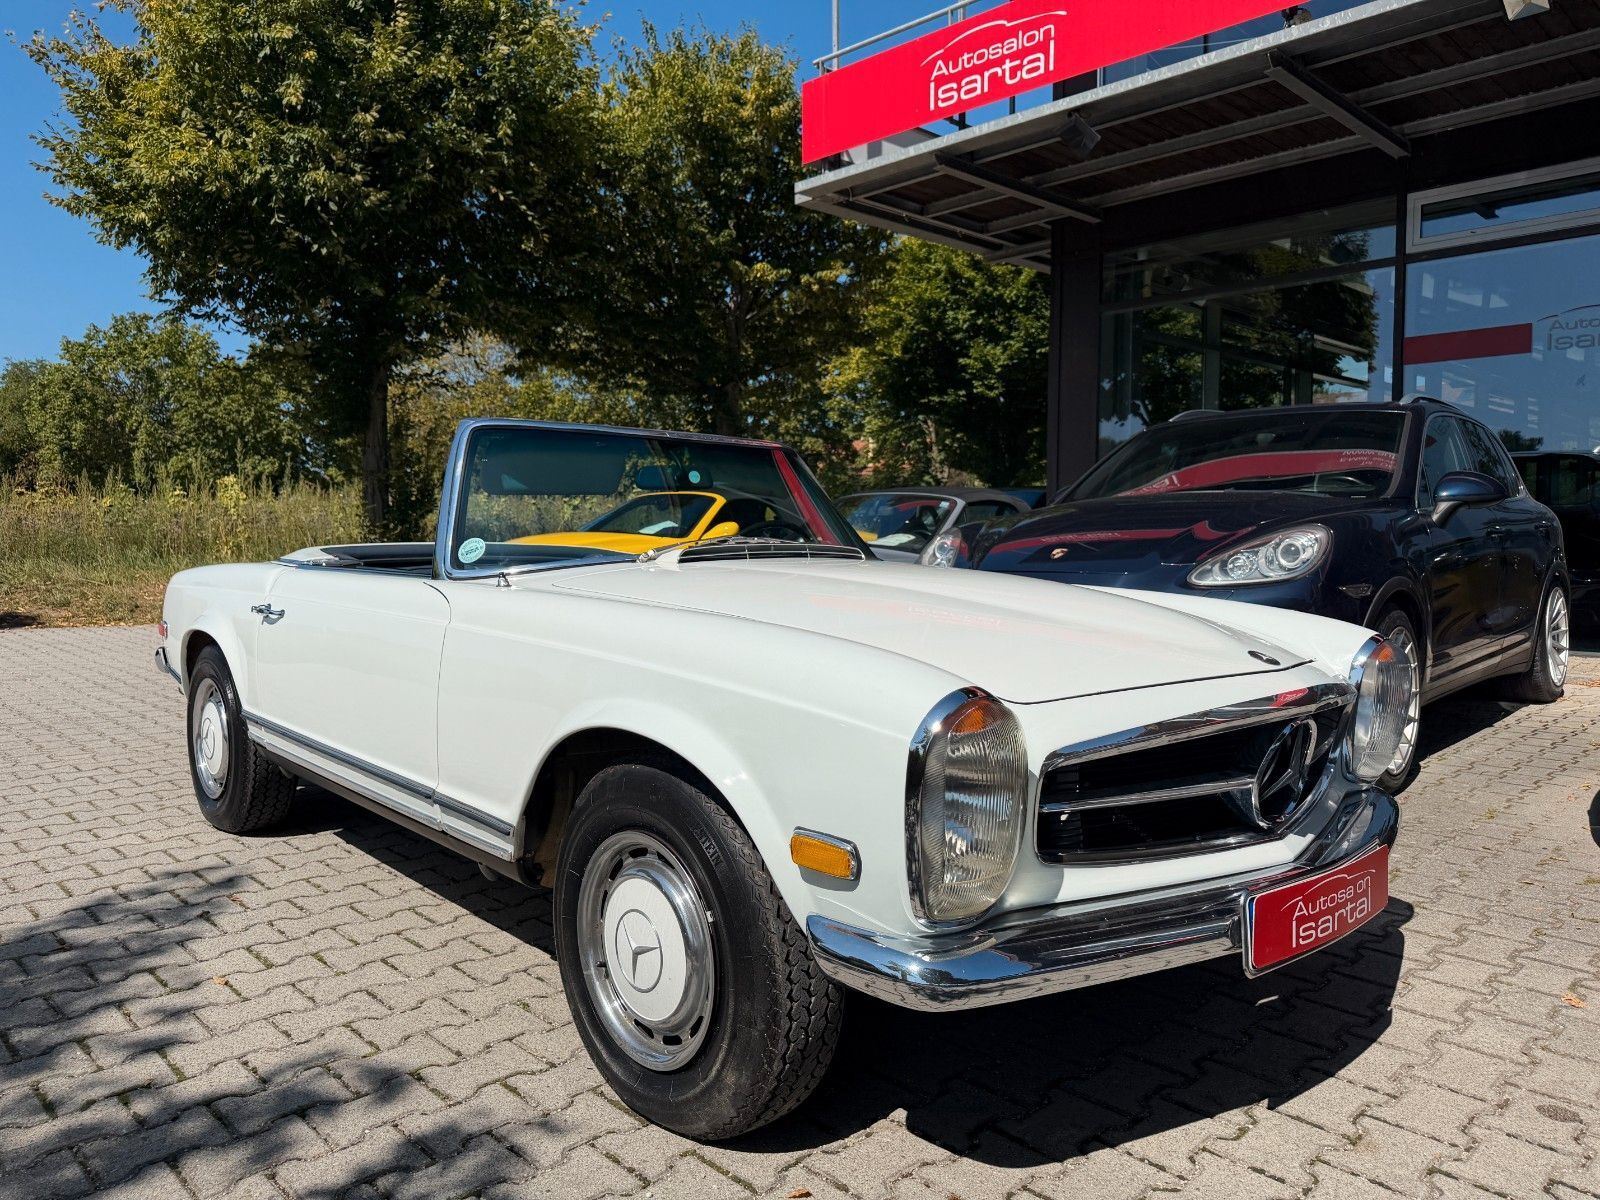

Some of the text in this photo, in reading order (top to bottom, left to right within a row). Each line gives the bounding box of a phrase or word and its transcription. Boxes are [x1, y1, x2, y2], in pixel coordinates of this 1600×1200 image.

[929, 40, 1055, 111] Isartal
[931, 24, 1055, 80] Autosalon
[1547, 333, 1600, 352] Isa
[1292, 887, 1371, 948] Isartal
